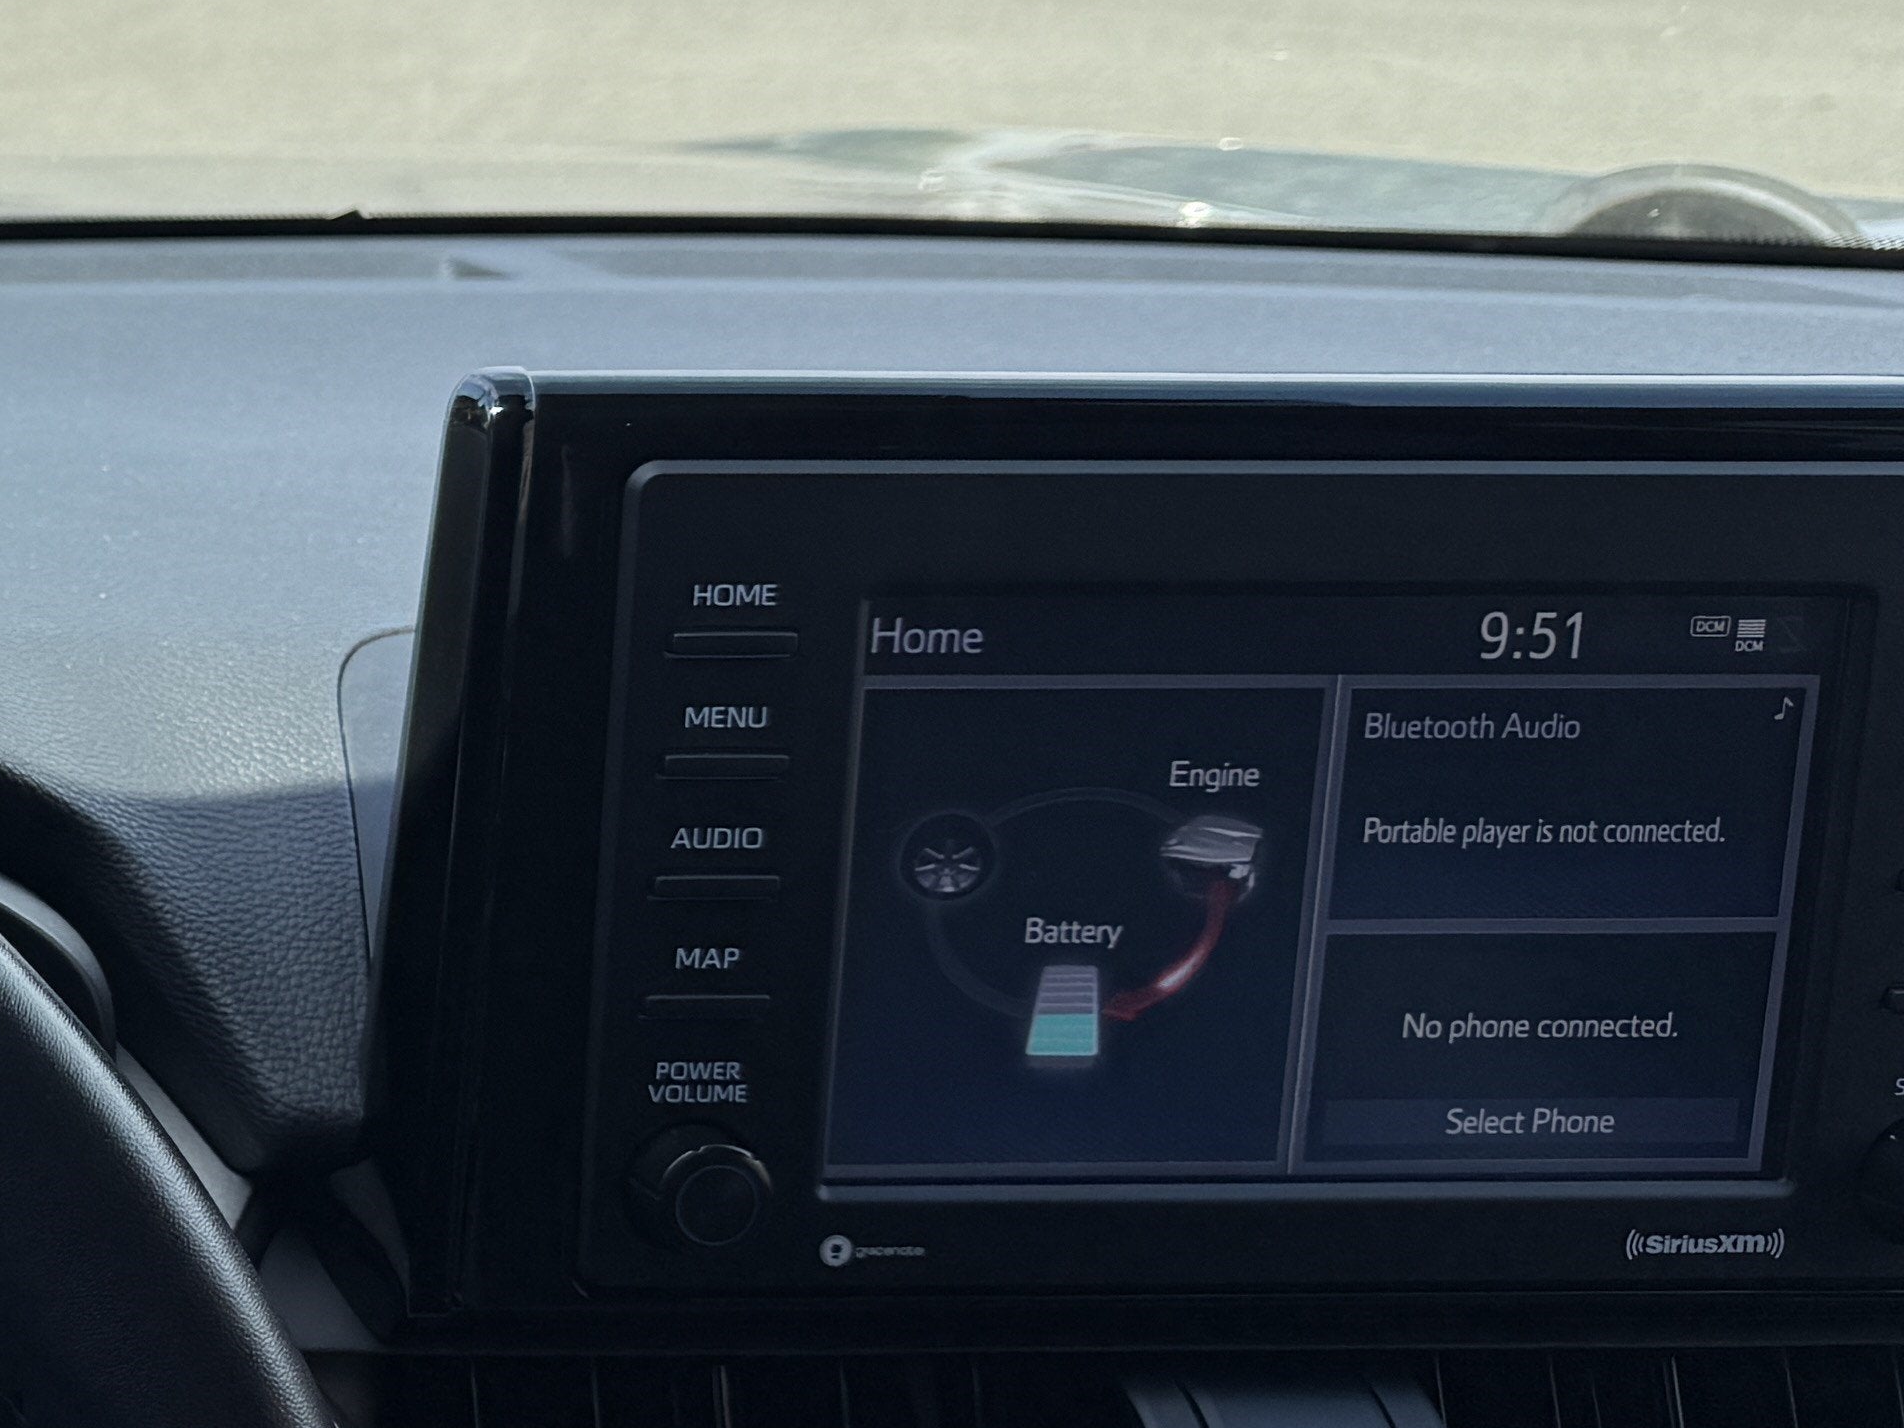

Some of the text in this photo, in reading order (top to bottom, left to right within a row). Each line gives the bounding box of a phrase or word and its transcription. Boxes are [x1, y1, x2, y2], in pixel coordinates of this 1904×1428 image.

[692, 583, 778, 607] HOME
[870, 617, 984, 654] Home
[1480, 611, 1583, 660] 9:51
[1734, 639, 1764, 652] DCM
[684, 706, 768, 729] MENU
[1364, 712, 1581, 740] Bluetooth Audio
[1169, 760, 1260, 793] Engine
[670, 827, 764, 850] AUDIO
[1363, 816, 1726, 850] Portable player is not connected.
[1024, 916, 1123, 949] Battery
[675, 947, 740, 969] MAP
[1402, 1011, 1678, 1045] No phone connected.
[655, 1061, 741, 1081] POWER
[648, 1084, 748, 1103] VOLUME
[1445, 1107, 1615, 1135] Select Phone
